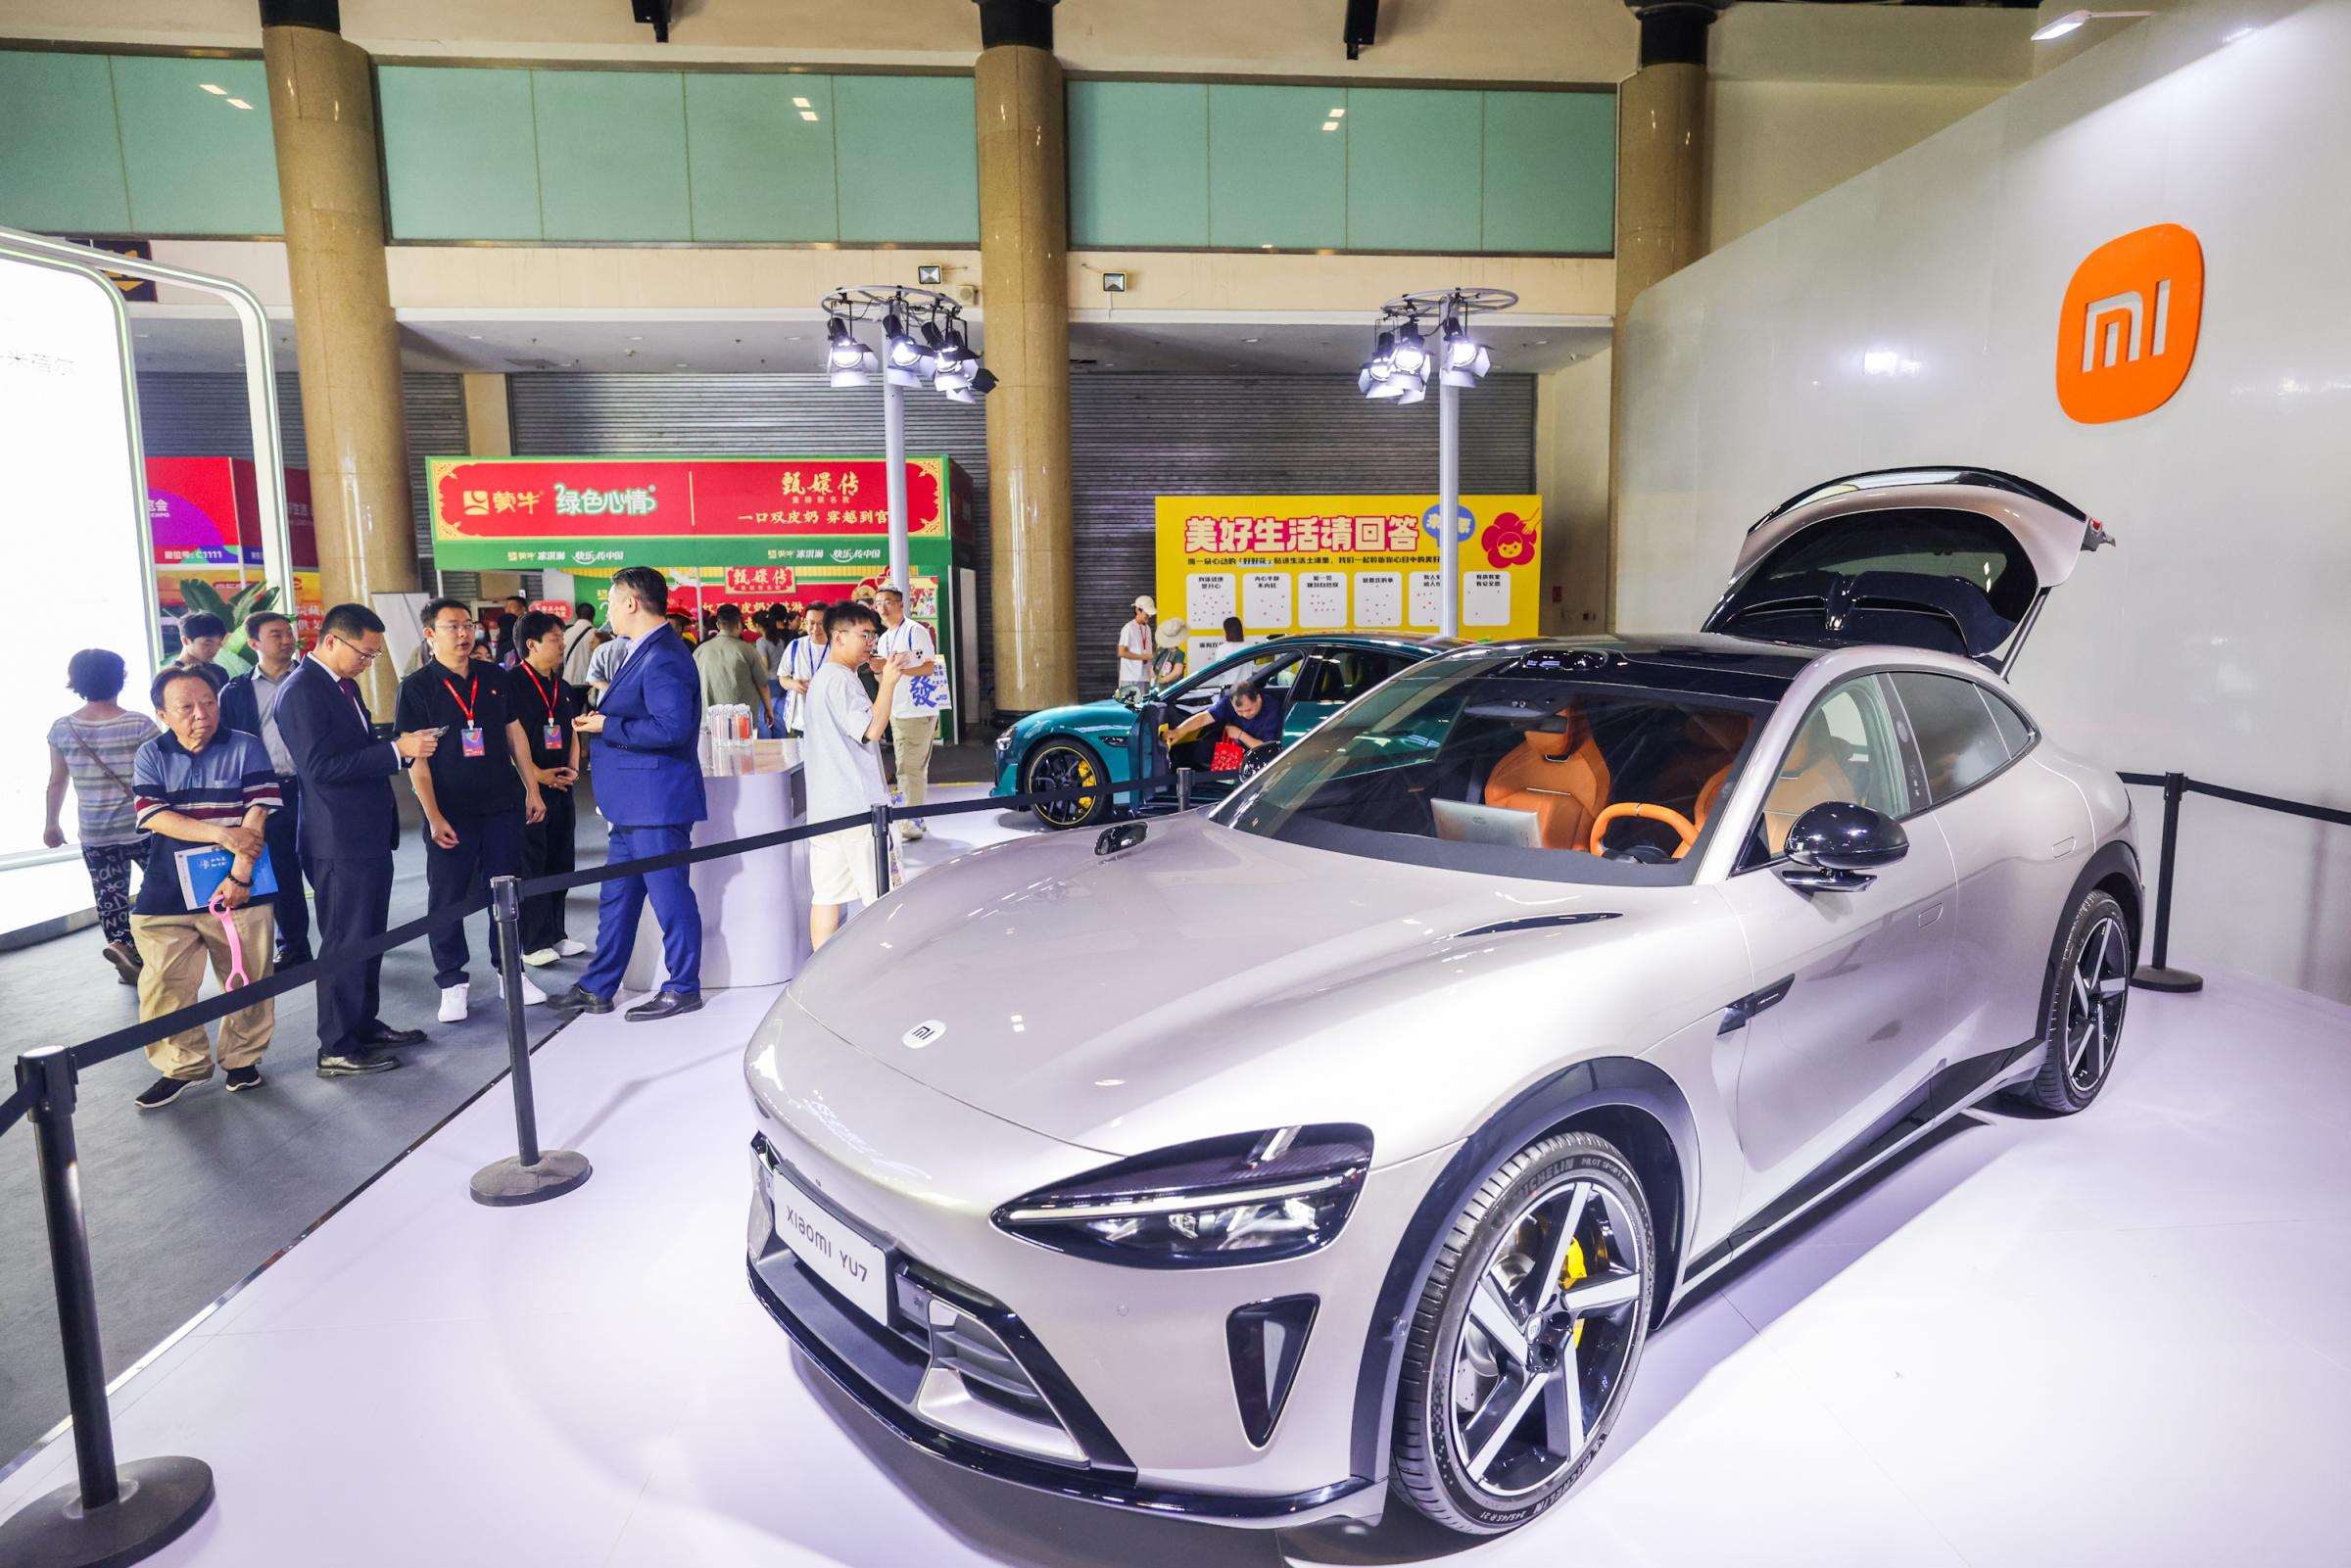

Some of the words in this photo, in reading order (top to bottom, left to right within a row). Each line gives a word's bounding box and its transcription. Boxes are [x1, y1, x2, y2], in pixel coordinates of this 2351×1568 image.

[781, 471, 859, 496] 甄嬛传
[492, 491, 540, 514] 蒙牛
[554, 483, 657, 515] 绿色心情
[738, 510, 820, 524] 一口双皮奶
[1185, 515, 1419, 553] 美好生活请回答
[840, 1250, 868, 1282] YU7
